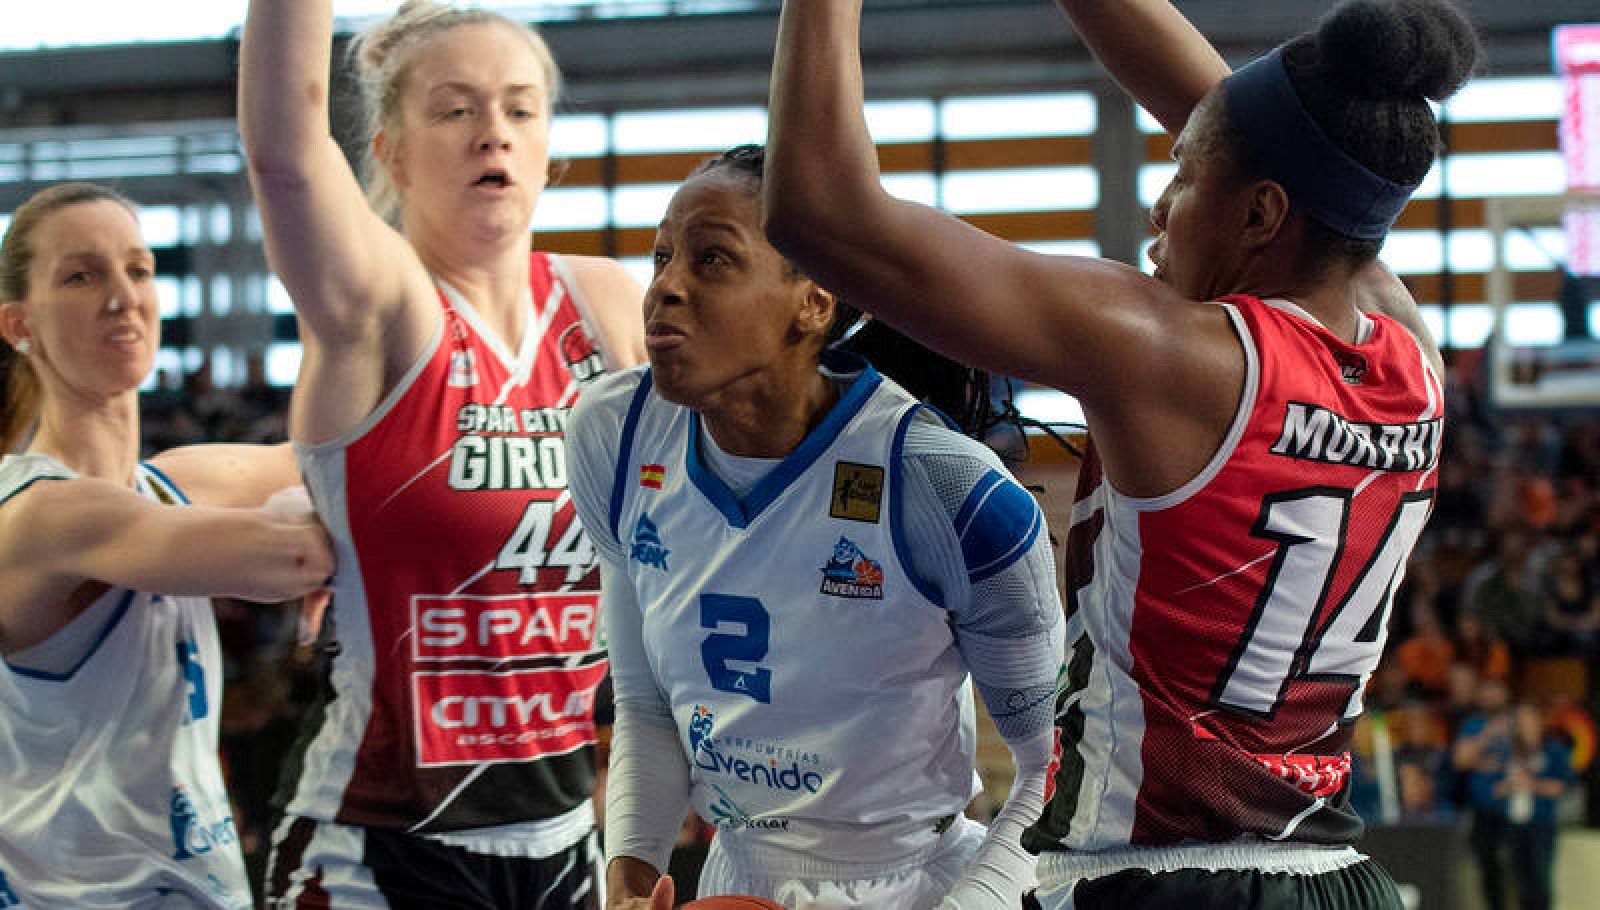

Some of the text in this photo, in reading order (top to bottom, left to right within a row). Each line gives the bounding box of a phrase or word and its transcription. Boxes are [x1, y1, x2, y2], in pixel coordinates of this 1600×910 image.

[457, 404, 519, 432] SPAR
[448, 434, 568, 490] GIRO
[495, 500, 597, 585] 44
[822, 579, 884, 598] AVENIDA
[1210, 486, 1435, 720] 14
[421, 604, 594, 647] SPAR
[700, 593, 772, 704] 2
